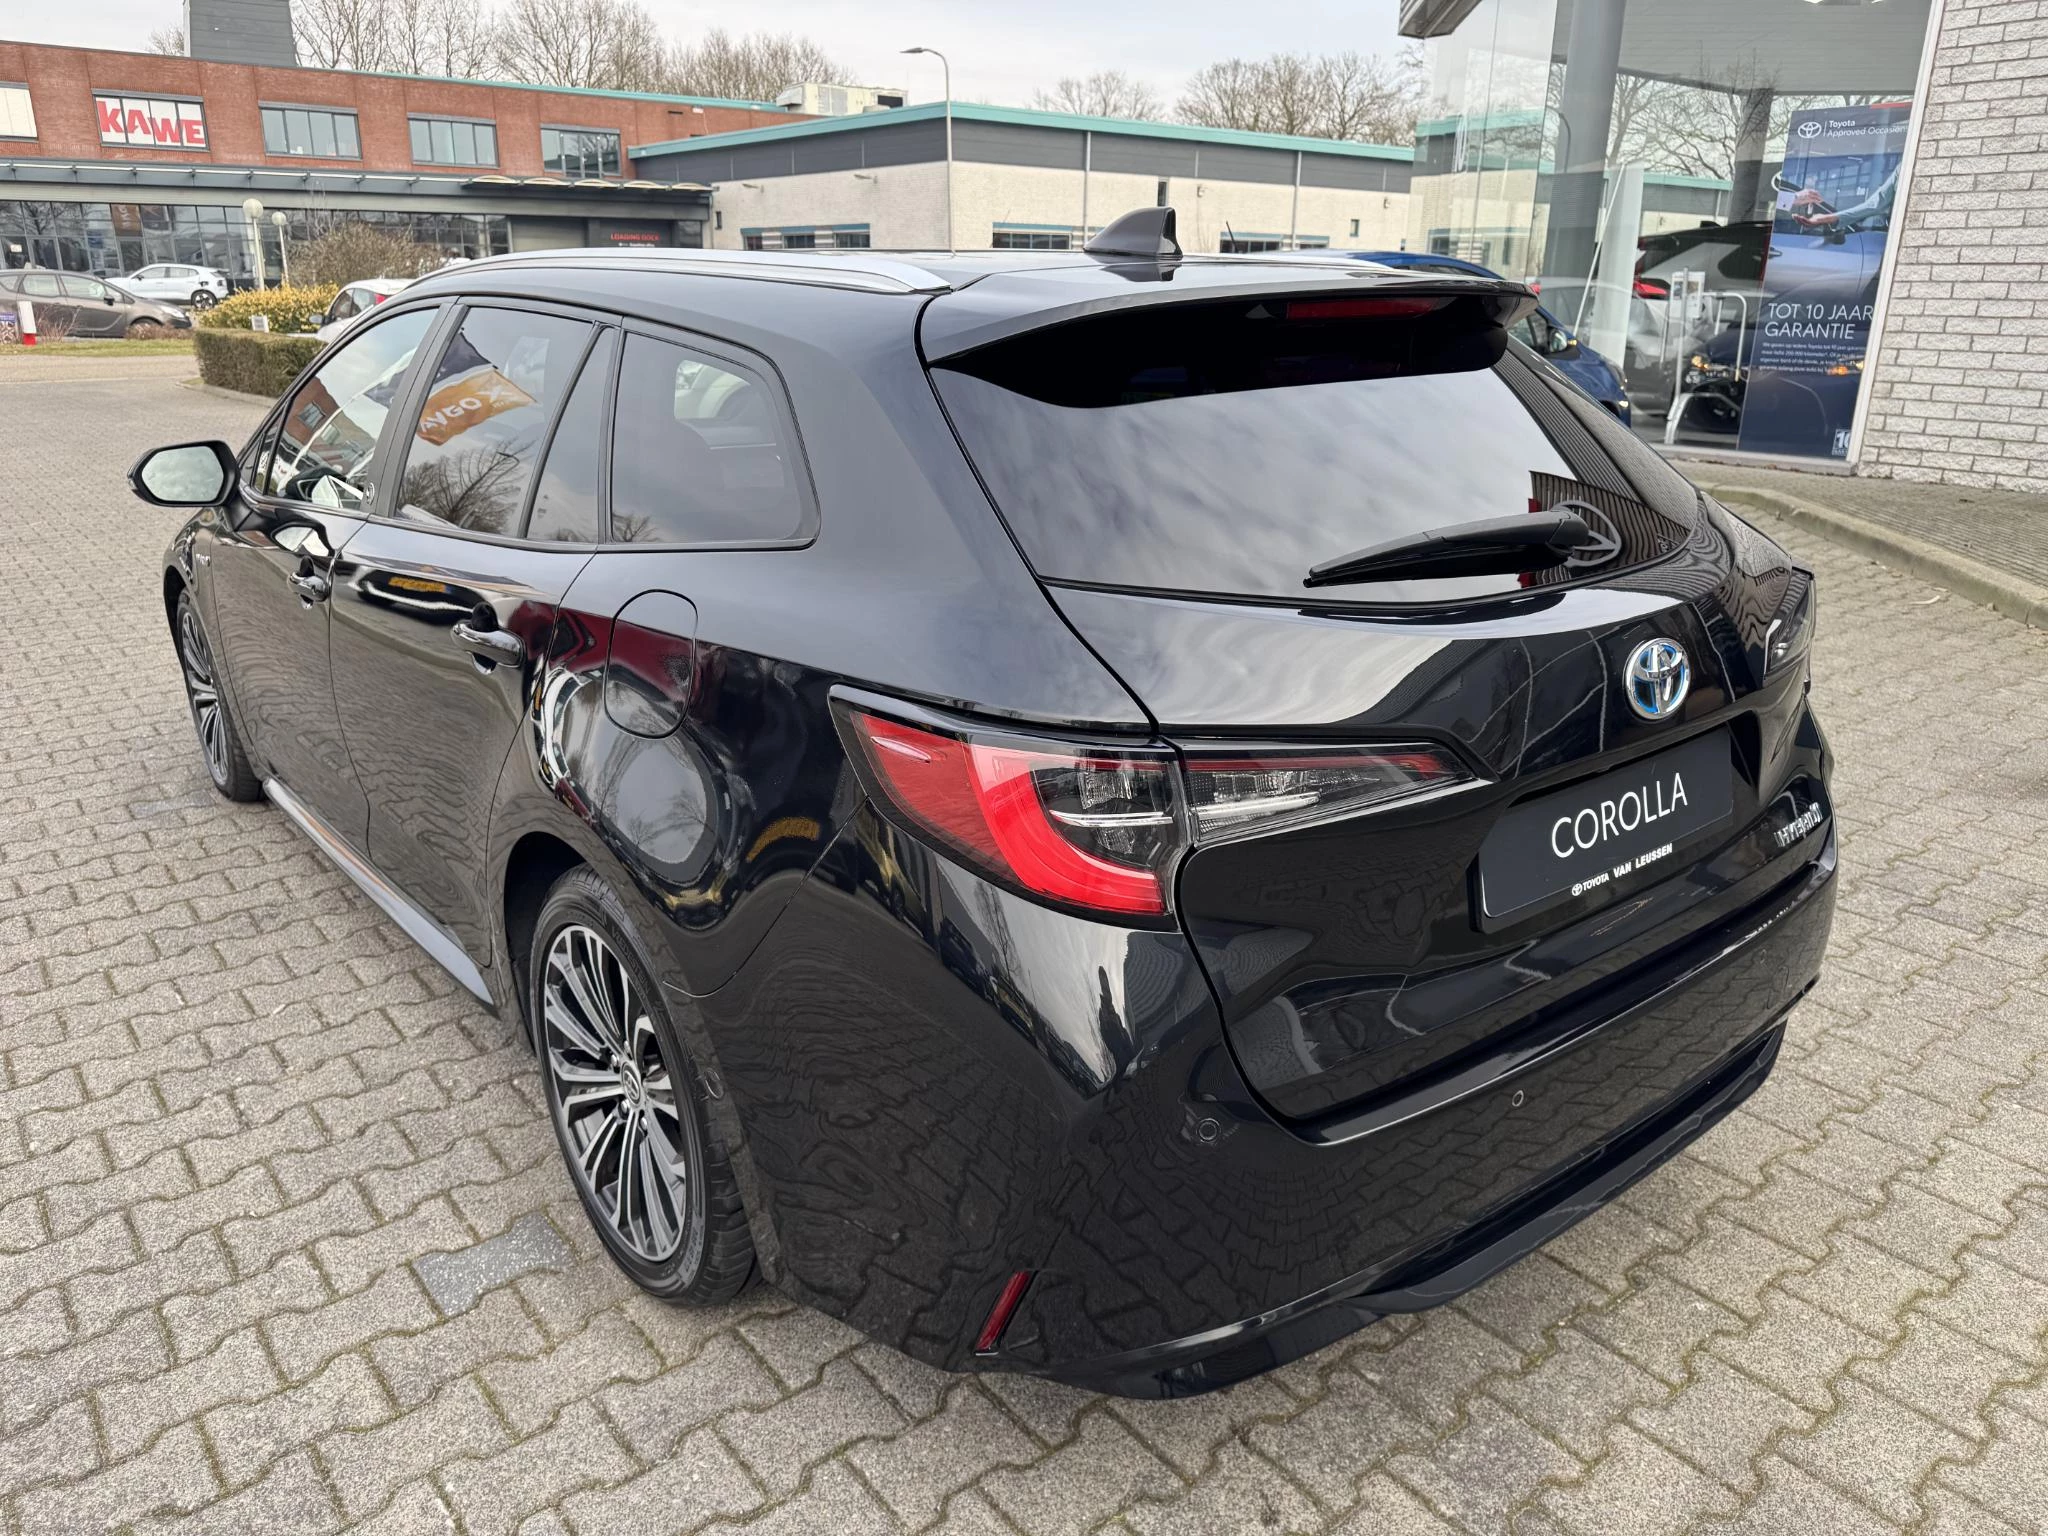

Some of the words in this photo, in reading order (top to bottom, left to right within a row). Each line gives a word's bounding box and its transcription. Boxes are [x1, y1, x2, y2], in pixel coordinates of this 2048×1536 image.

[97, 101, 205, 144] KAWE
[1828, 120, 1856, 129] Toyota
[1827, 127, 1866, 138] Approved
[1768, 303, 1801, 319] TOT
[1806, 304, 1824, 320] 10
[1828, 304, 1874, 321] JAAR
[1764, 321, 1856, 340] GARANTIE
[1551, 772, 1688, 858] COROLLA
[1582, 873, 1609, 891] TOYOTA
[1613, 862, 1632, 878] VAN
[1635, 843, 1673, 868] LEUSSEN
